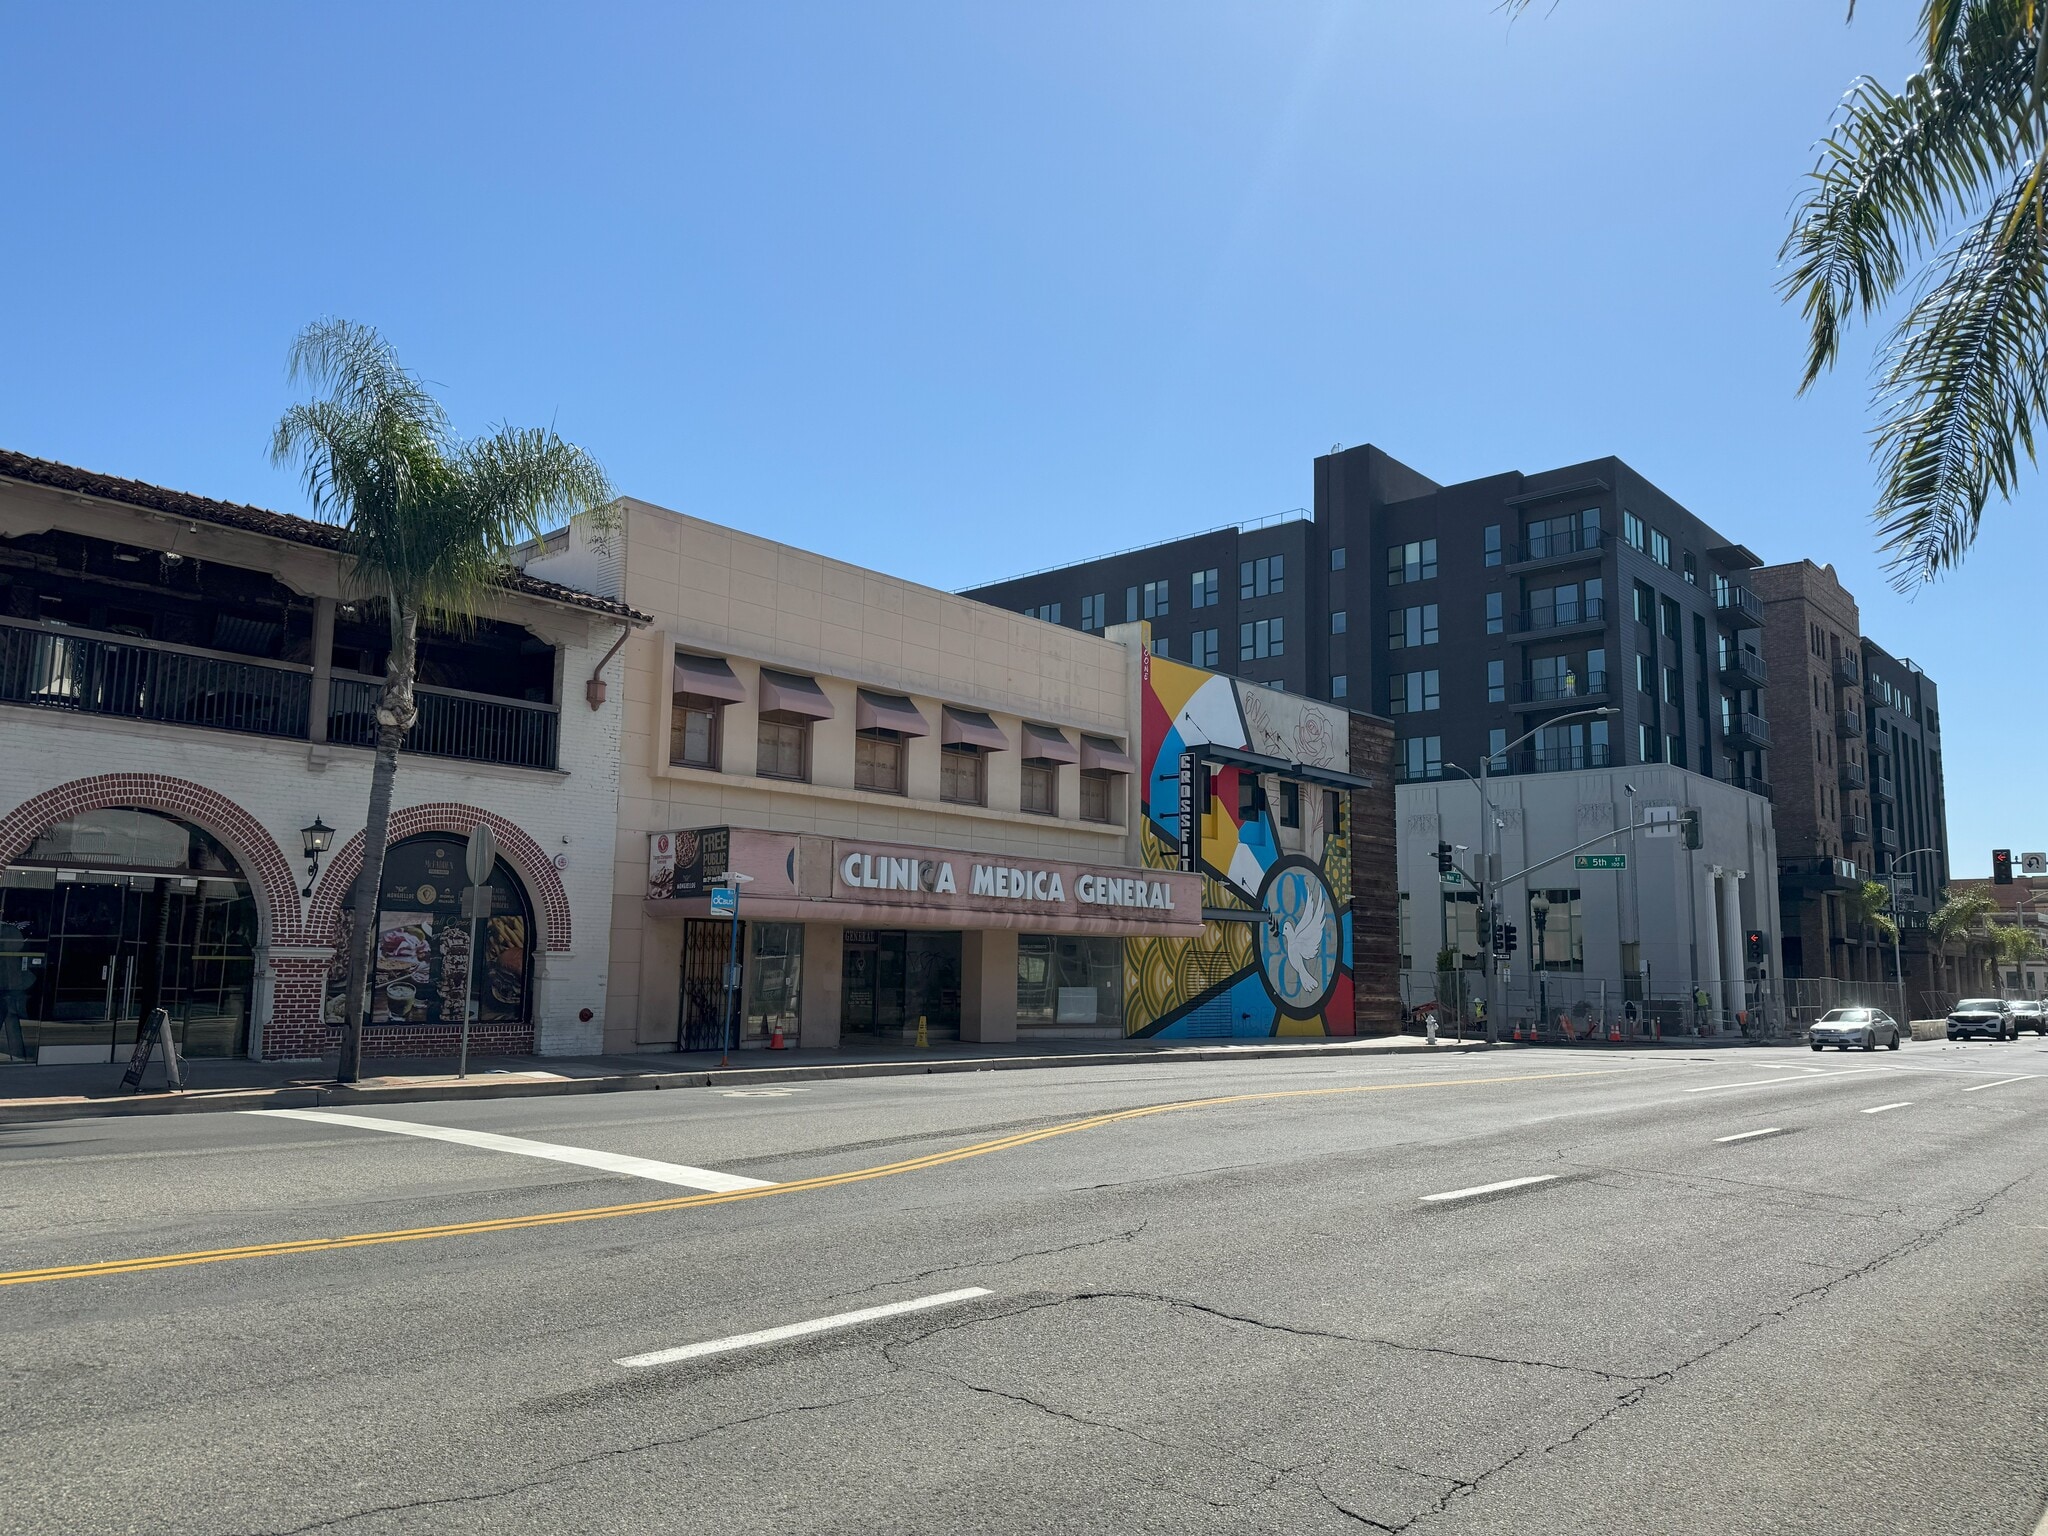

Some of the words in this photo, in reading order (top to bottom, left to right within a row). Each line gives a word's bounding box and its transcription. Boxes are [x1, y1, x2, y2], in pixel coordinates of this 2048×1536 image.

[1180, 755, 1191, 872] CROSSFIT
[703, 831, 727, 852] FREE
[703, 852, 726, 866] PUBLIC
[1592, 858, 1607, 867] 5th
[703, 865, 726, 876] PARKING
[840, 852, 957, 894] CLINICA
[969, 863, 1066, 902] MEDICA
[1074, 874, 1175, 910] GENERAL
[845, 930, 875, 942] GENERAL
